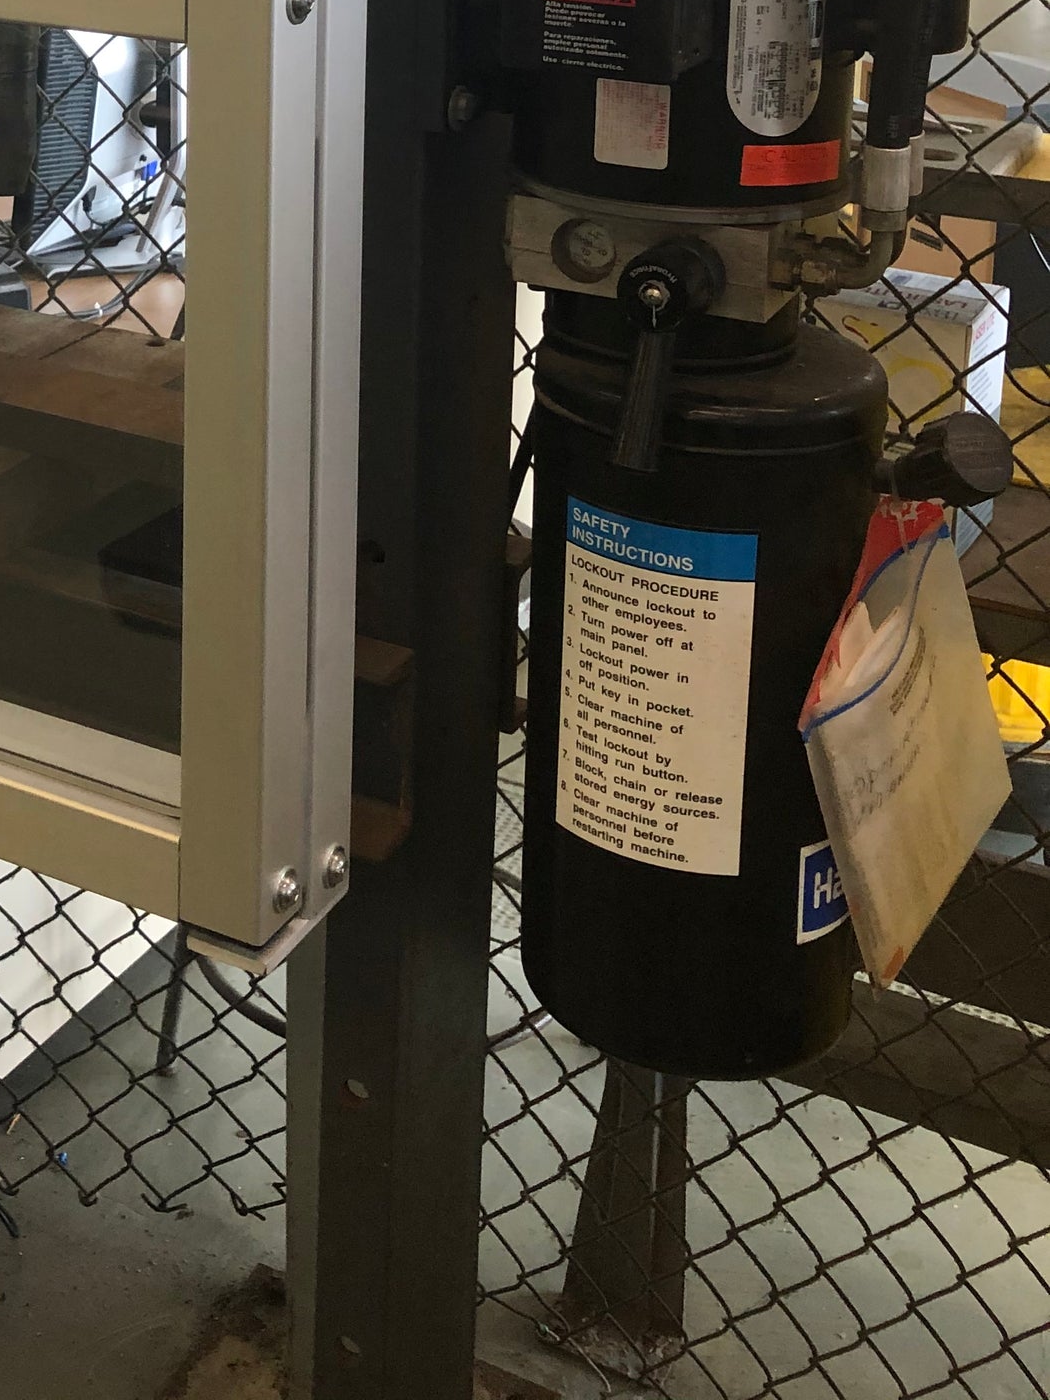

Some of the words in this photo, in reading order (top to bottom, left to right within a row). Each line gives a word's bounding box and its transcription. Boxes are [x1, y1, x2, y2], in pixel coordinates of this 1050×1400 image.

[572, 506, 631, 539] SAFETY
[572, 525, 694, 572] INSTRUCTIONS
[569, 572, 577, 584] 1.
[582, 579, 639, 607] Announce
[646, 600, 695, 619] lockout
[703, 609, 716, 621] to
[571, 553, 625, 584] LOCKOUT
[631, 576, 719, 602] PROCEDURE
[567, 605, 575, 617] 2.
[581, 611, 605, 629] Turn
[611, 624, 649, 643] power
[655, 636, 674, 648] off
[681, 641, 693, 651] at
[582, 594, 609, 613] other
[615, 609, 687, 632] employees.
[566, 636, 574, 648] 3.
[579, 643, 624, 669] Lockout
[630, 663, 670, 681] power
[677, 672, 689, 684] in
[580, 627, 606, 645] main
[612, 640, 648, 658] panel.
[565, 669, 573, 680] 4.
[578, 675, 596, 692] Put
[601, 685, 621, 702] key
[628, 694, 639, 707] in
[646, 700, 694, 718] pocket.
[579, 659, 593, 672] off
[598, 668, 650, 691] position.
[564, 686, 572, 698] 5.
[577, 693, 604, 713] Clear
[610, 708, 663, 731] machine
[670, 724, 684, 735] of
[577, 709, 588, 721] all
[594, 717, 656, 745] personnel.
[563, 718, 571, 730] 6.
[576, 724, 598, 743] Test
[604, 737, 649, 760] lockout
[655, 753, 671, 767] by
[576, 739, 609, 764] hitting
[615, 757, 635, 772] run
[642, 765, 688, 783] button.
[562, 749, 570, 761] 7.
[575, 756, 607, 781] Block,
[613, 775, 647, 792] chain
[654, 787, 668, 797] or
[675, 791, 723, 805] release
[574, 772, 607, 794] stored
[613, 789, 655, 811] energy
[663, 803, 720, 820] sources.
[560, 780, 568, 792] 8.
[573, 788, 600, 808] Clear
[606, 804, 658, 827] machine
[665, 821, 679, 832] of
[573, 803, 627, 833] personnel
[634, 826, 675, 846] before
[572, 816, 624, 849] restarting
[630, 842, 689, 863] machine.
